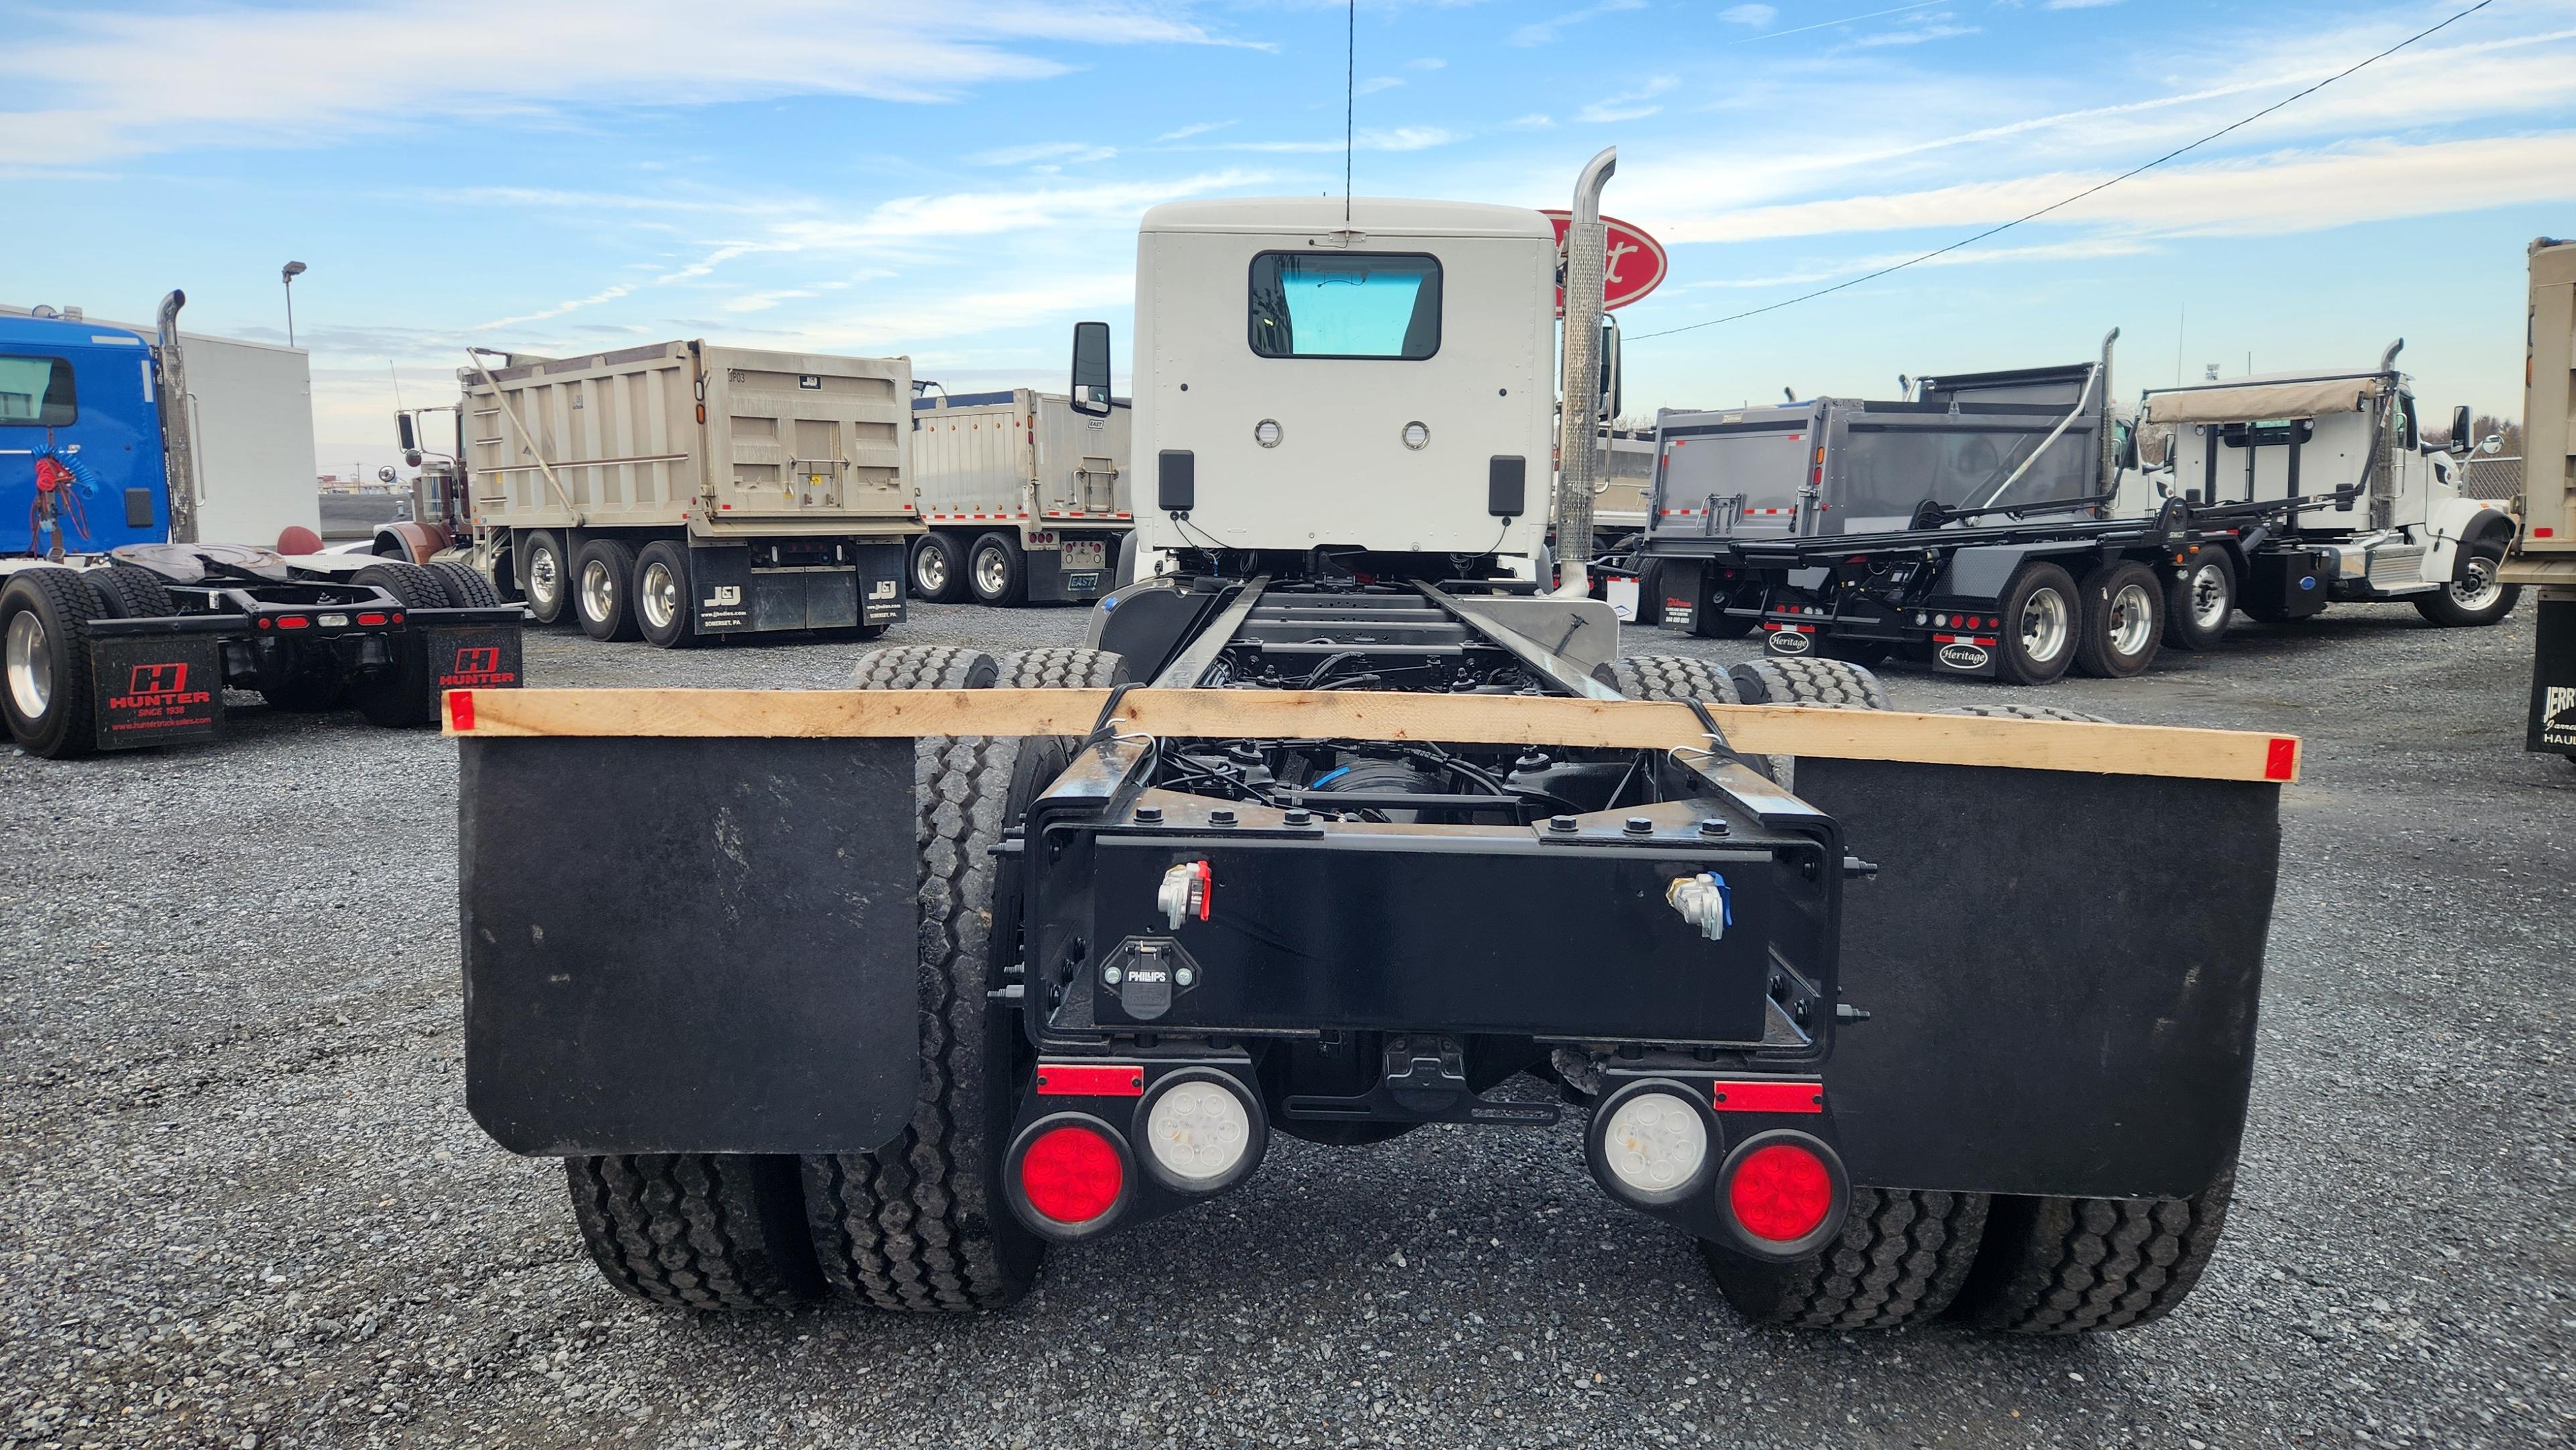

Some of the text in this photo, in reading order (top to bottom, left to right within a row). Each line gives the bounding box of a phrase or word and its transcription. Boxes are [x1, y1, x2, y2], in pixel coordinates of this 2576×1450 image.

[1071, 577, 1094, 586] EAST
[704, 586, 741, 607] J&J
[869, 580, 896, 600] J&J
[1771, 635, 1807, 650] Heritage
[1942, 648, 1985, 664] Heritage
[439, 672, 515, 685] HUNTER
[109, 692, 210, 709] HUNTER
[2543, 686, 2576, 723] JERR
[138, 706, 185, 717] SINCE 1938
[112, 717, 211, 731] www.huntertrucksales.com
[2545, 719, 2576, 731] Jarre
[1128, 971, 1167, 982] PHILLIPS
